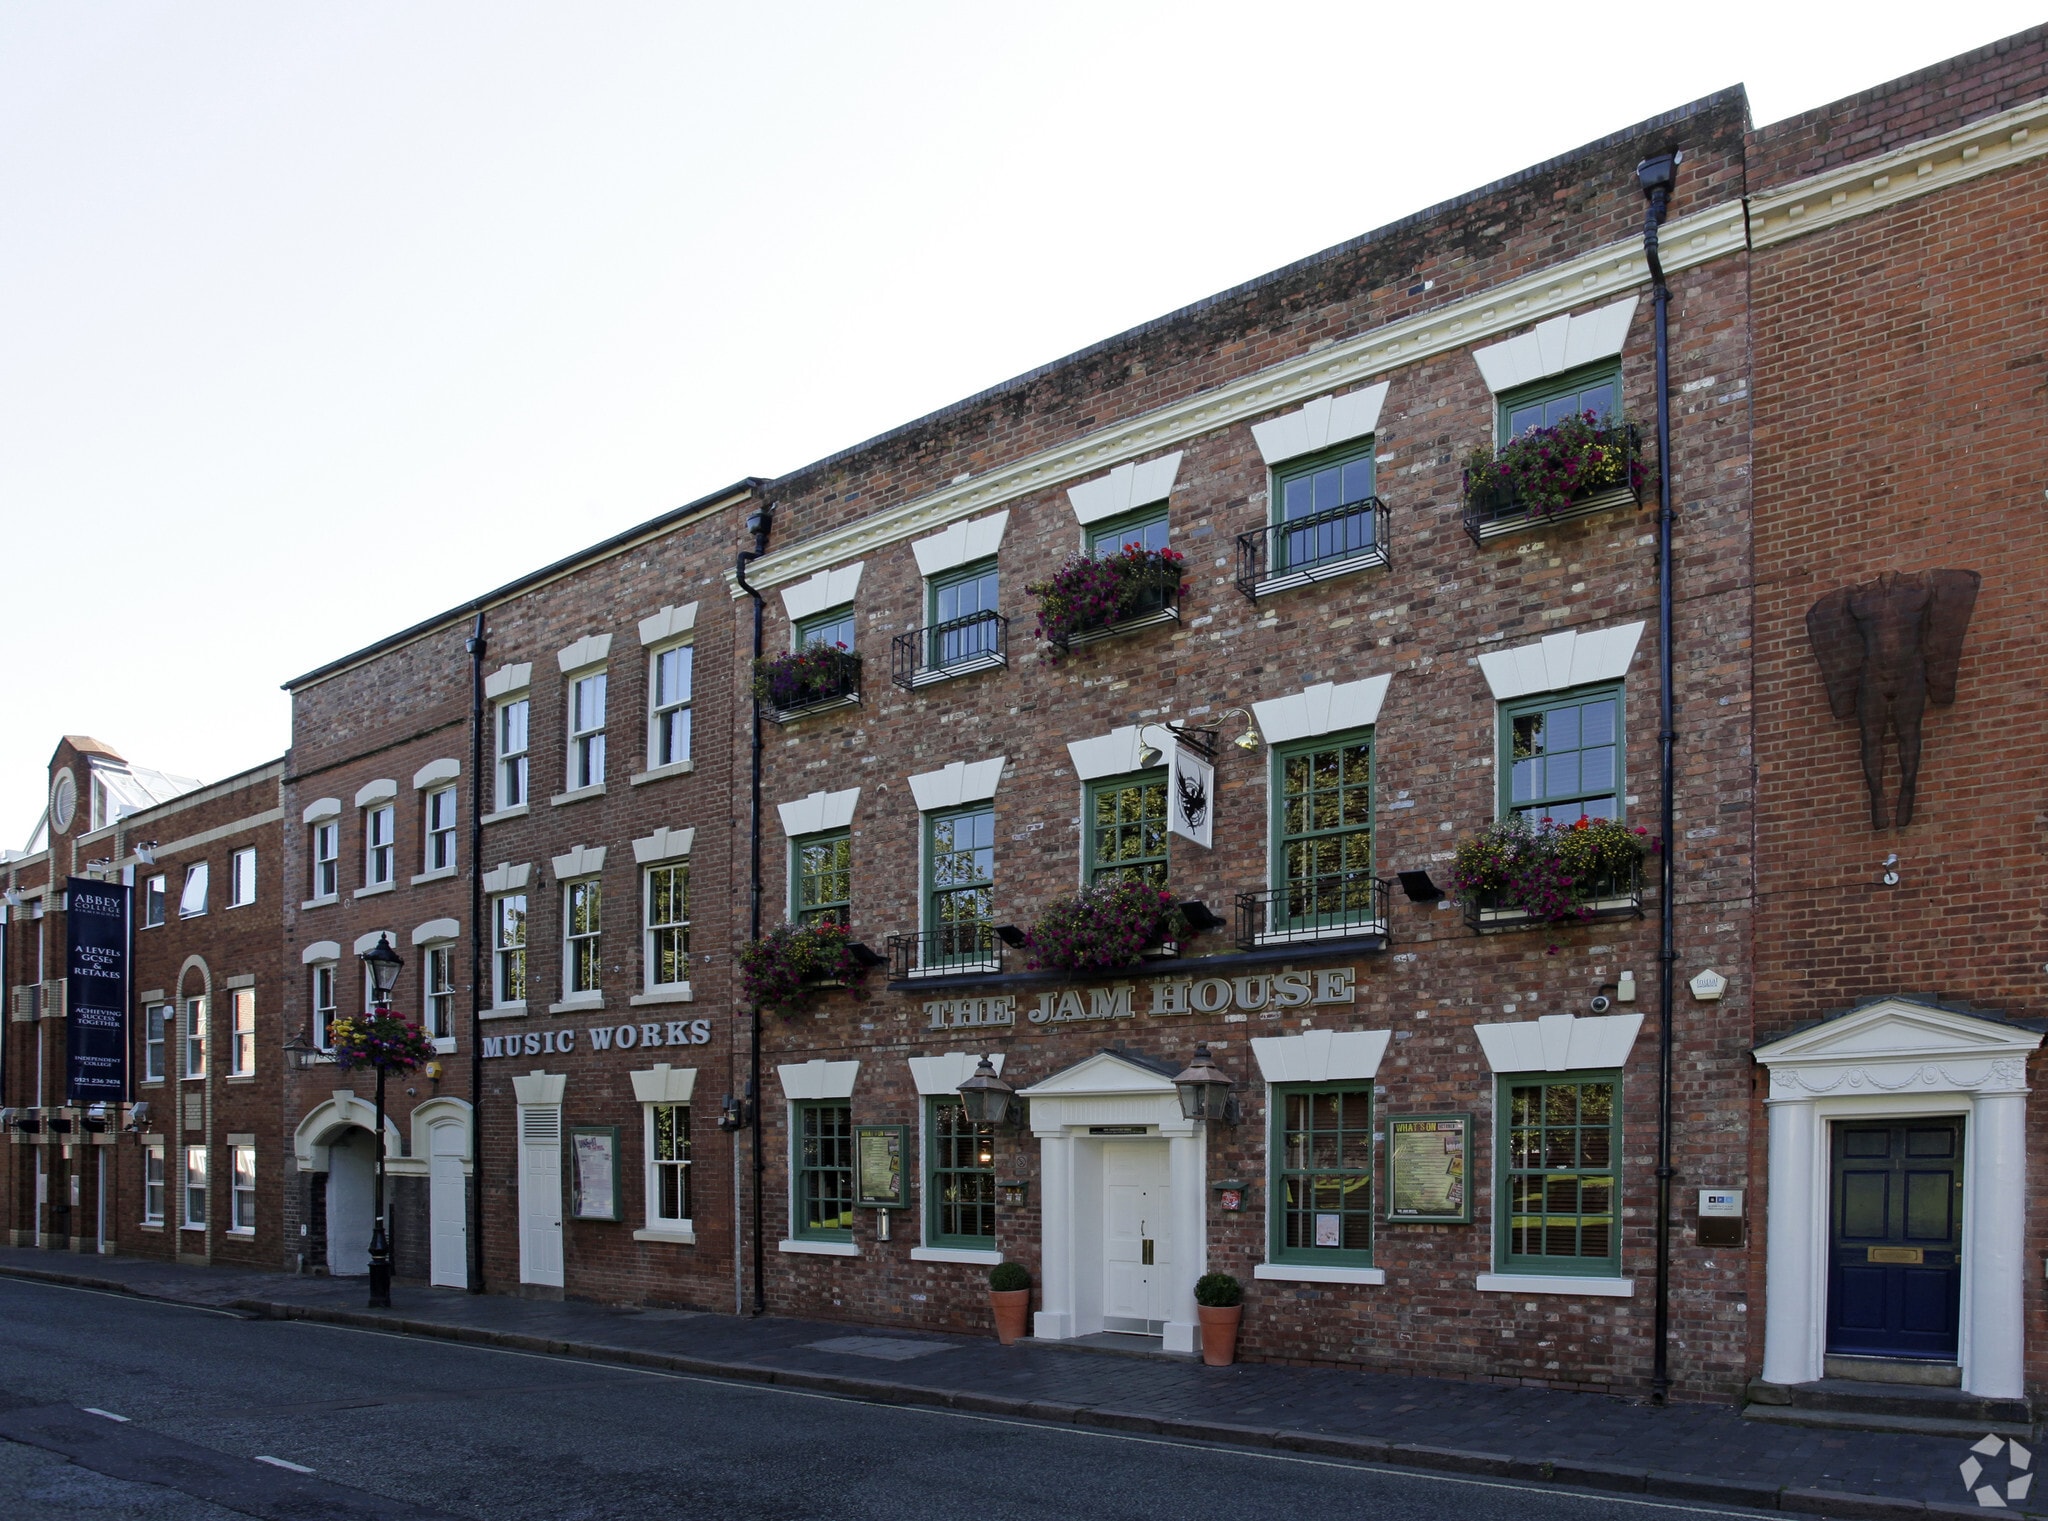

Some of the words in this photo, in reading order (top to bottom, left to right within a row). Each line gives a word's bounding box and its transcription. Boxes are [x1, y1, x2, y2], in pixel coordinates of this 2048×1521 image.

[75, 894, 120, 907] ABBEY
[75, 903, 120, 913] COLLEGE
[74, 968, 120, 978] RETAKES
[923, 994, 1016, 1030] THE
[1028, 985, 1136, 1024] JAM
[1148, 967, 1356, 1016] HOUSE
[75, 1007, 122, 1017] ACHIEVING
[82, 1013, 115, 1021] SUCCESS
[78, 1018, 120, 1027] TOGETHER
[482, 1029, 576, 1058] MUSIC
[589, 1019, 712, 1050] WORKS
[1426, 1122, 1437, 1131] ON
